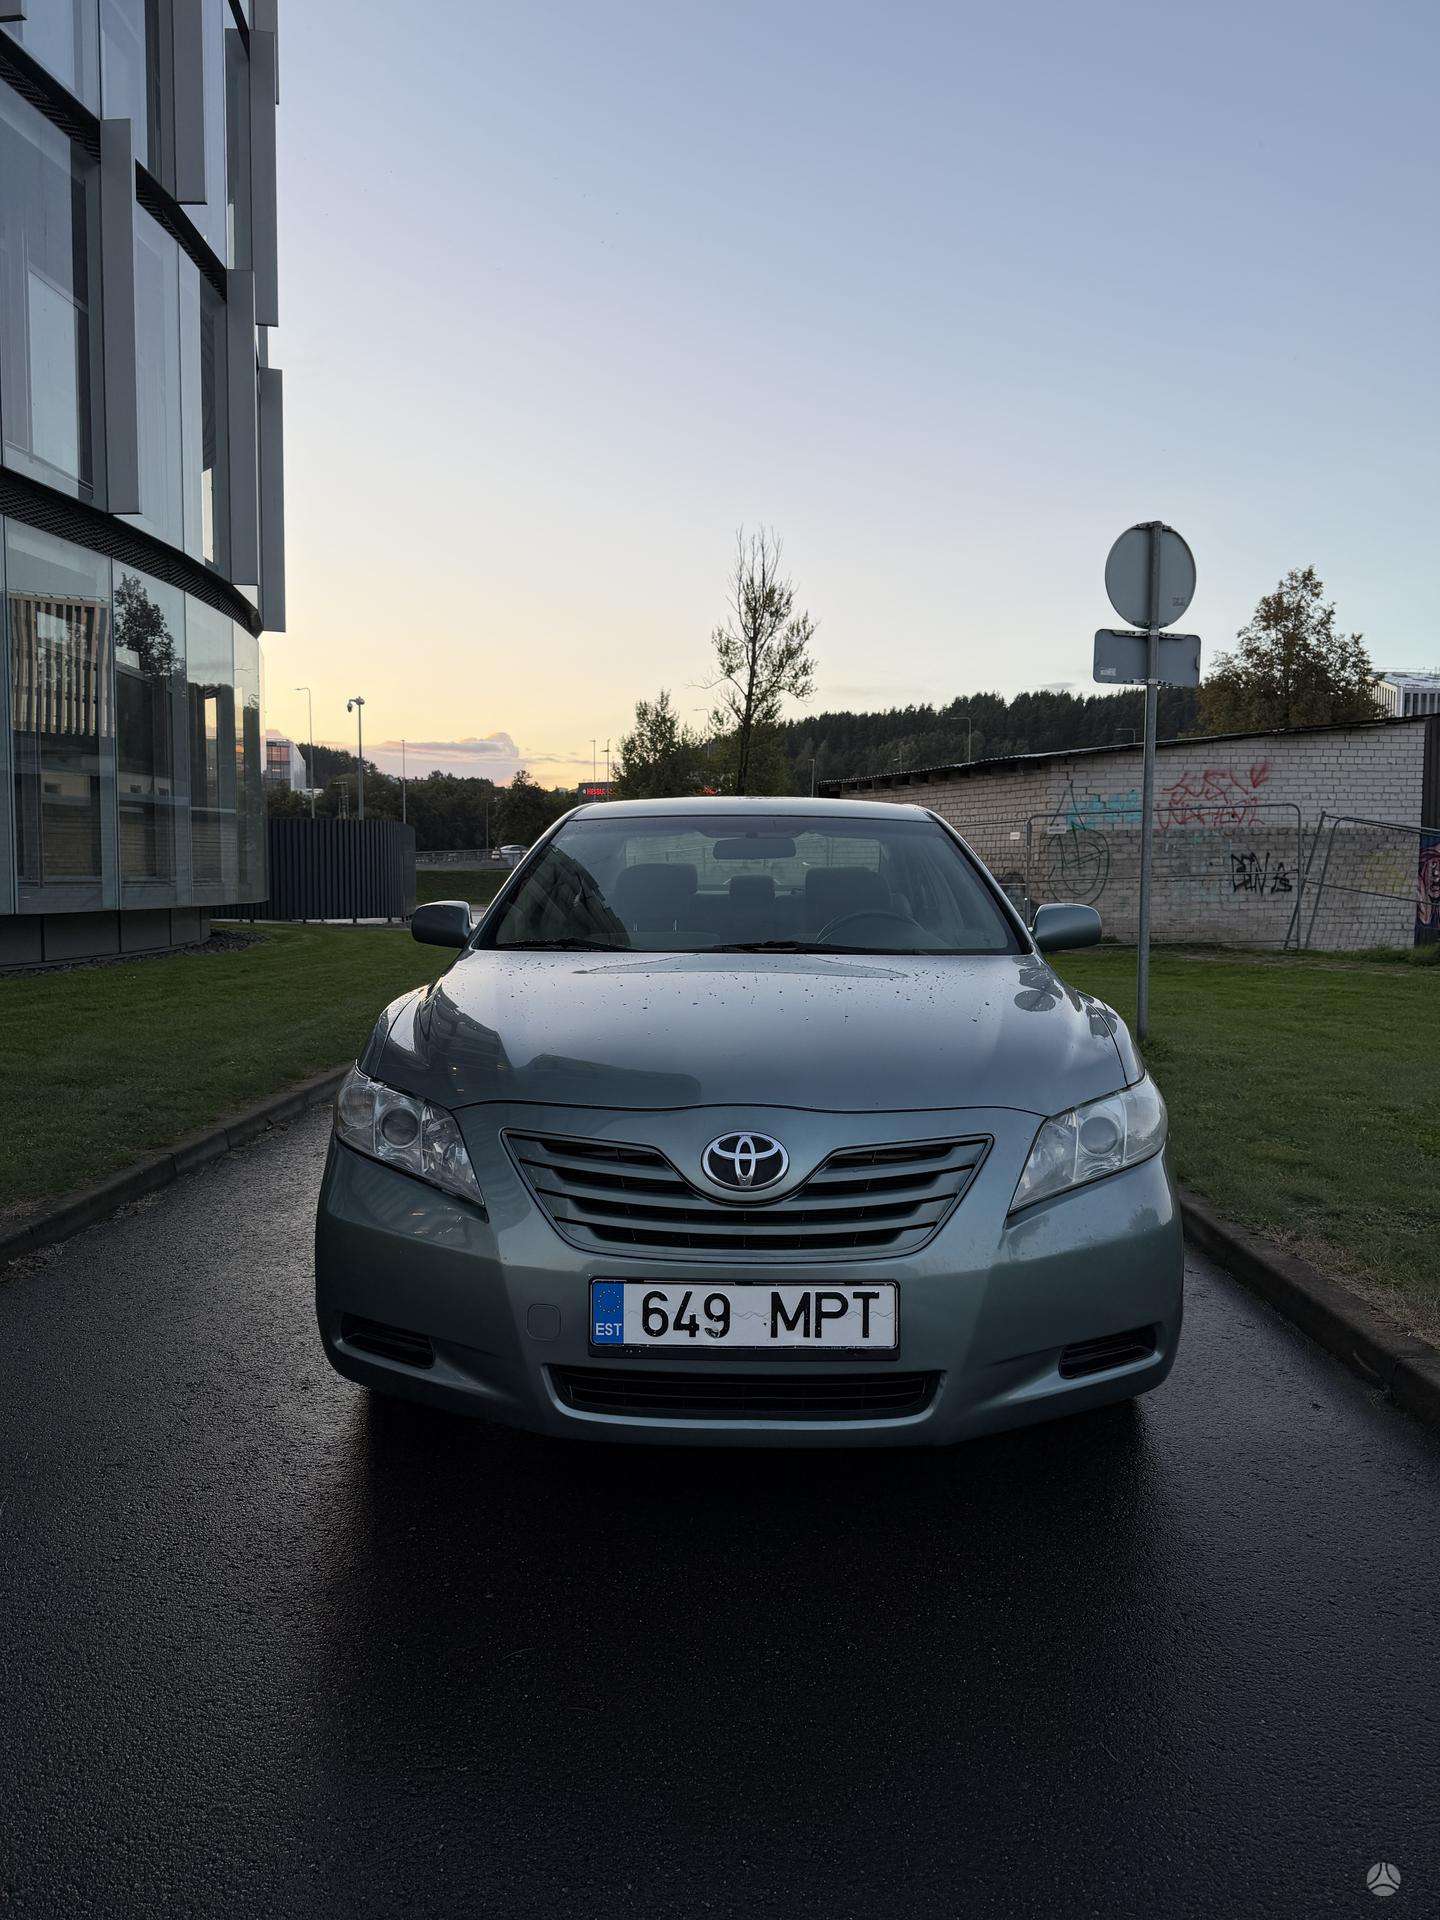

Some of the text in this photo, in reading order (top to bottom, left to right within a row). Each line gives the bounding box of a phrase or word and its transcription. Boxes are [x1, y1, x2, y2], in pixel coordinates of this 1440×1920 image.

[595, 1322, 622, 1337] EST
[641, 1290, 880, 1339] 649 MPT
